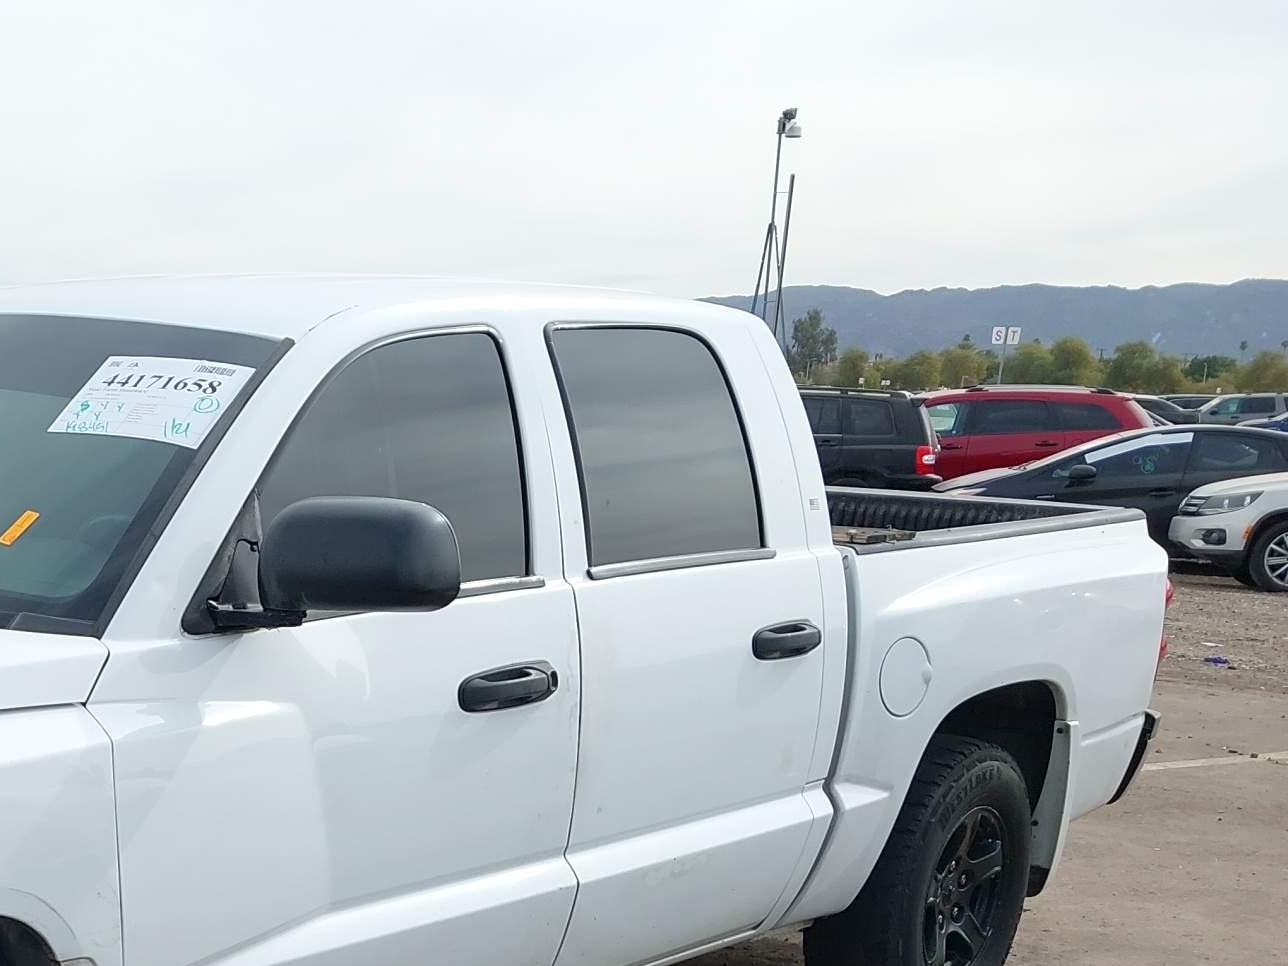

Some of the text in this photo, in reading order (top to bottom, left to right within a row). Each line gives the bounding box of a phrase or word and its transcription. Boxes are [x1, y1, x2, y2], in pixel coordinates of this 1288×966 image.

[994, 329, 1018, 342] S T
[102, 372, 223, 395] 44171658
